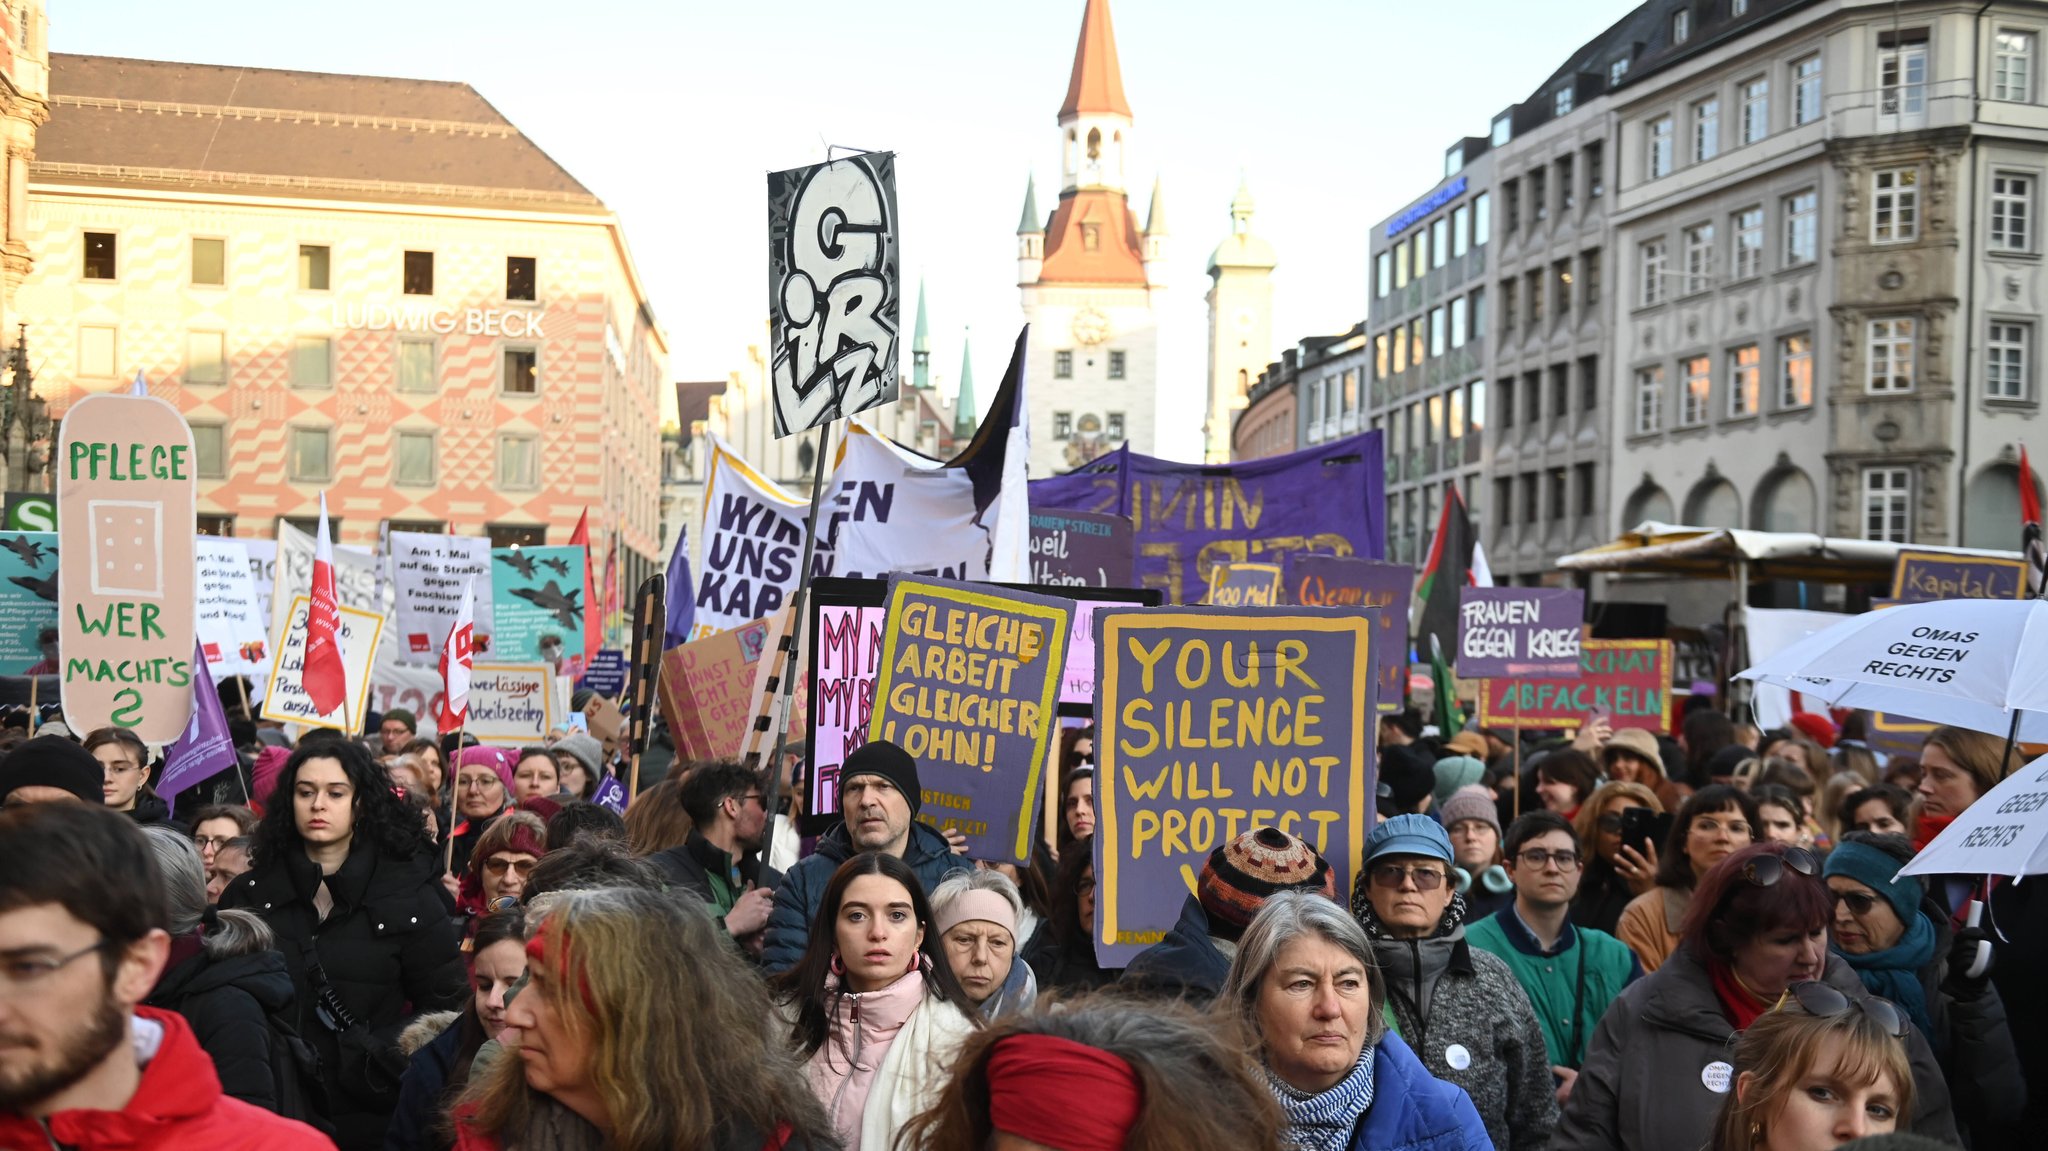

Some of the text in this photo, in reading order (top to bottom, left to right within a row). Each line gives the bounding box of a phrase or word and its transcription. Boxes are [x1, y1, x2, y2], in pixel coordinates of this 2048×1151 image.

[331, 303, 545, 338] LUDWIG BECK
[70, 441, 188, 481] PFLEGE
[411, 547, 431, 557] Am
[449, 550, 470, 560] Mai
[708, 532, 797, 583] UNS
[1029, 530, 1069, 559] weil
[399, 562, 485, 575] auf die Straße
[423, 577, 460, 588] gegen
[408, 589, 478, 603] Faschisms
[413, 605, 435, 613] und
[76, 603, 167, 640] WER
[1462, 599, 1540, 628] FRAUEN
[823, 607, 862, 680] MY
[900, 602, 1044, 659] GLEICHE
[1463, 627, 1580, 659] GEGEN KRIEG
[1911, 626, 1980, 643] OMAS
[281, 654, 304, 671] Loh
[1127, 636, 1322, 694] YOUR
[1886, 641, 1971, 663] GEGEN
[66, 656, 191, 688] MACHT'S
[469, 675, 540, 694] verlässige
[895, 643, 1021, 694] ARBEIT
[1862, 660, 1956, 684] RECHTS
[818, 678, 855, 732] MY
[889, 682, 1042, 740] GLEICHER
[1499, 684, 1663, 716] ABFACKELN
[1120, 695, 1325, 758] SILENCE
[884, 720, 997, 773] LOHN!
[1122, 756, 1341, 801] WILL NOT
[1958, 824, 2025, 848] RECHTS
